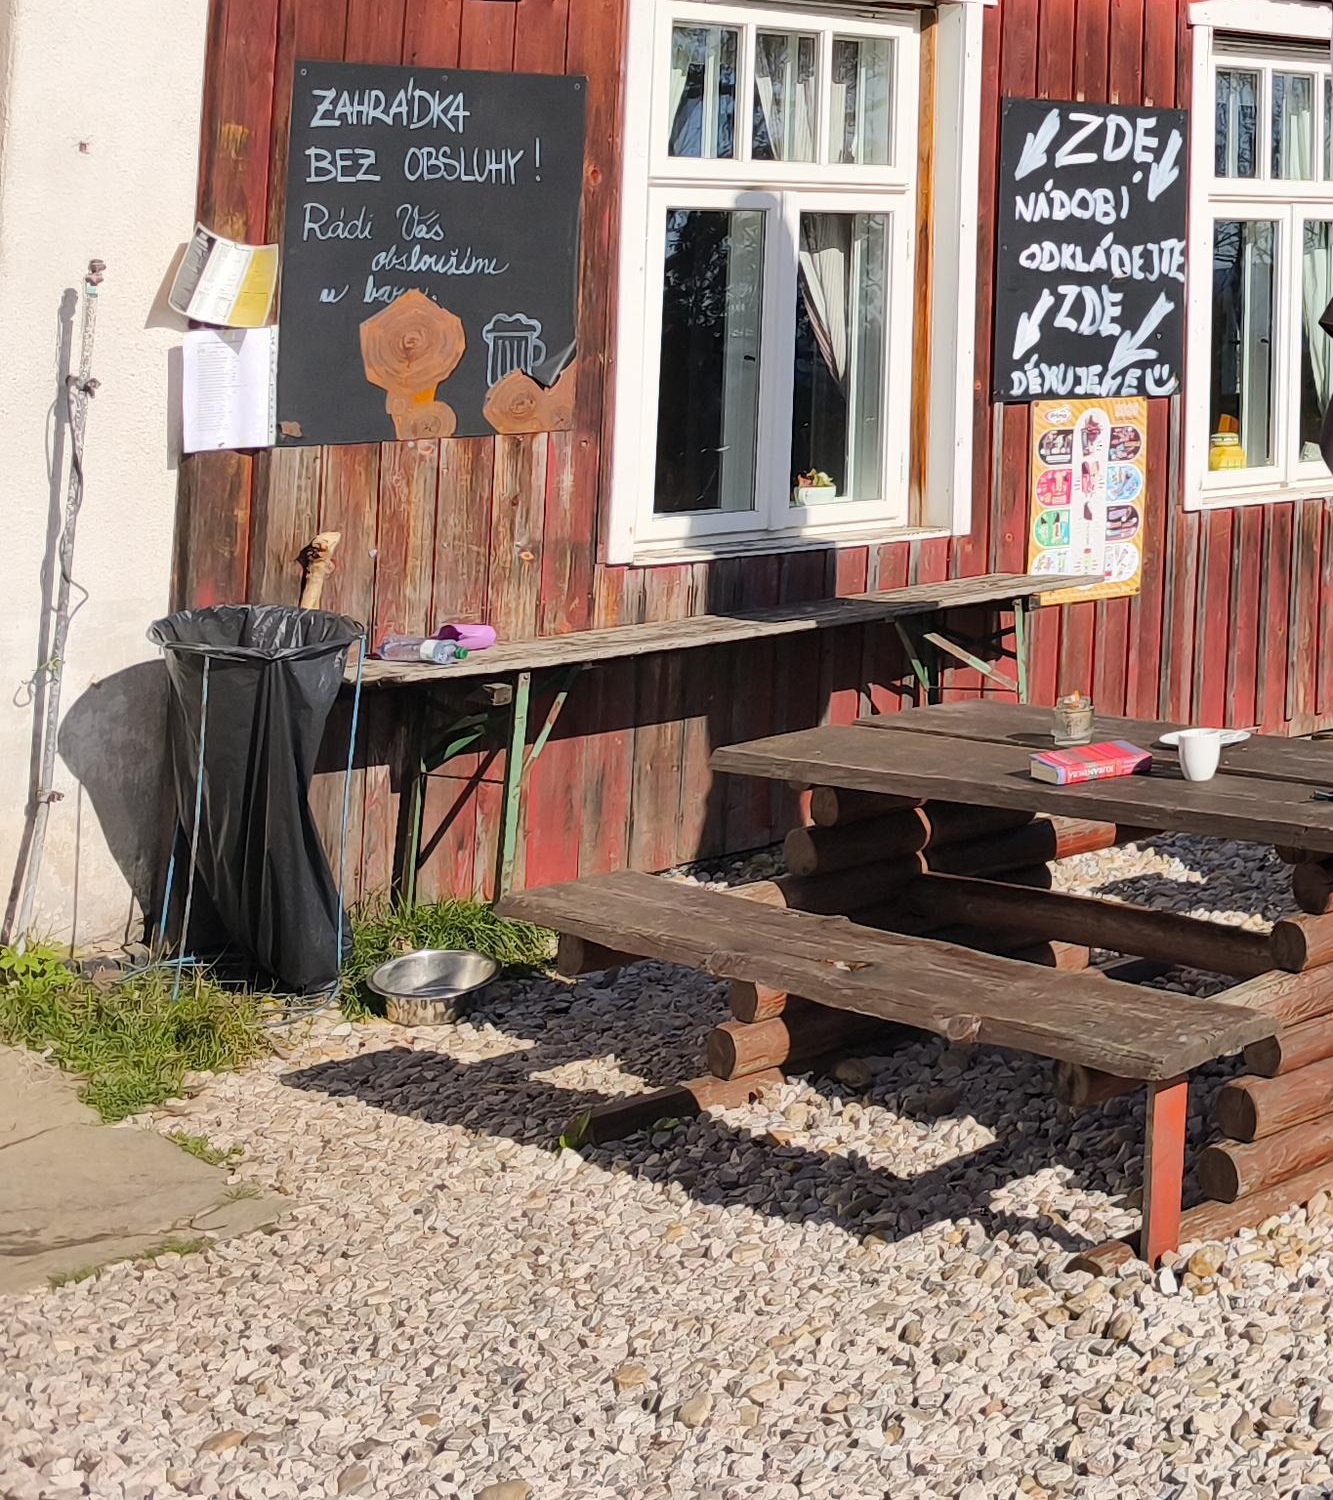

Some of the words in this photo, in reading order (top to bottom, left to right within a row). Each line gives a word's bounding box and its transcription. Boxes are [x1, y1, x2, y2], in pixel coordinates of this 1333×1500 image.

[310, 77, 470, 134] ZAHRÁDKA
[305, 146, 381, 182] BEZ
[1054, 112, 1159, 169] ZDE
[303, 202, 374, 241] Rádi
[396, 203, 445, 241] Vás
[1015, 170, 1143, 225] NÁDOBÍ
[371, 244, 510, 275] obsloužíme
[1019, 231, 1185, 282] ODKLÁDEJTE
[1053, 284, 1124, 337] ZDE
